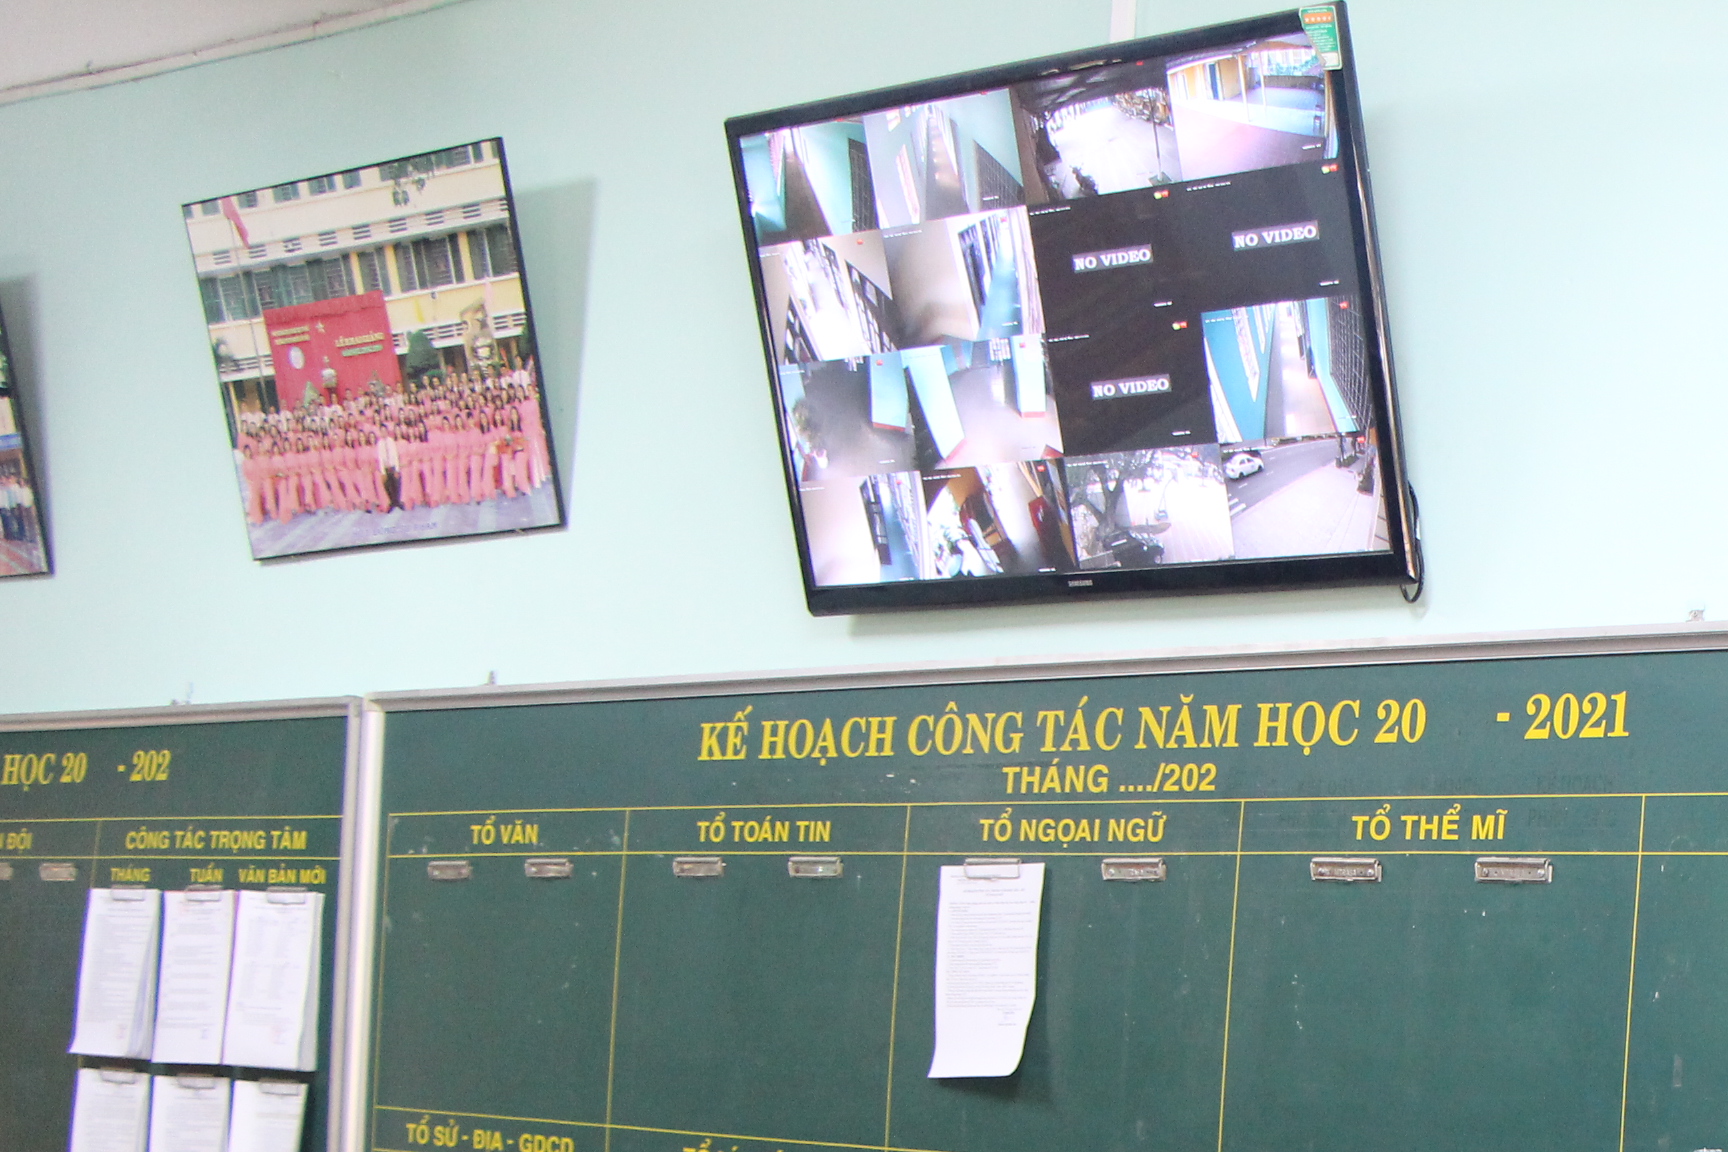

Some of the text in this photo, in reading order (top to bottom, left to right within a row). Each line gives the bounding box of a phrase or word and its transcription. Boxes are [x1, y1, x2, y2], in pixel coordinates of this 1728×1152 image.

[1233, 225, 1317, 249] NO VIDEO
[1073, 248, 1151, 270] NO VIDEO
[1091, 379, 1169, 397] NO VIDEO
[697, 705, 754, 761] KẾ
[758, 716, 897, 766] HOẠCH
[906, 701, 1025, 756] CÔNG
[1036, 695, 1126, 752] TÁC
[1133, 693, 1242, 750] NĂM
[1253, 698, 1362, 756] HỌC
[1373, 697, 1428, 744] 20
[1524, 690, 1631, 740] 2021
[60, 752, 88, 783] 20
[129, 750, 171, 782] 202
[1001, 758, 1110, 794] THÁNG
[470, 815, 539, 846] TỔ VĂN
[696, 812, 832, 843] TỔ TOÁN TIN
[978, 808, 1013, 842] TỔ
[1106, 811, 1168, 843] NGỮ
[1352, 804, 1509, 841] TỔ THỂ MĨ
[125, 826, 308, 853] CÔNG TÁC TRỌNG TÂM
[110, 863, 151, 882] THÁNG
[238, 864, 265, 884] VĂN
[406, 1118, 430, 1146] TỔ
[433, 1120, 459, 1148] SỬ
